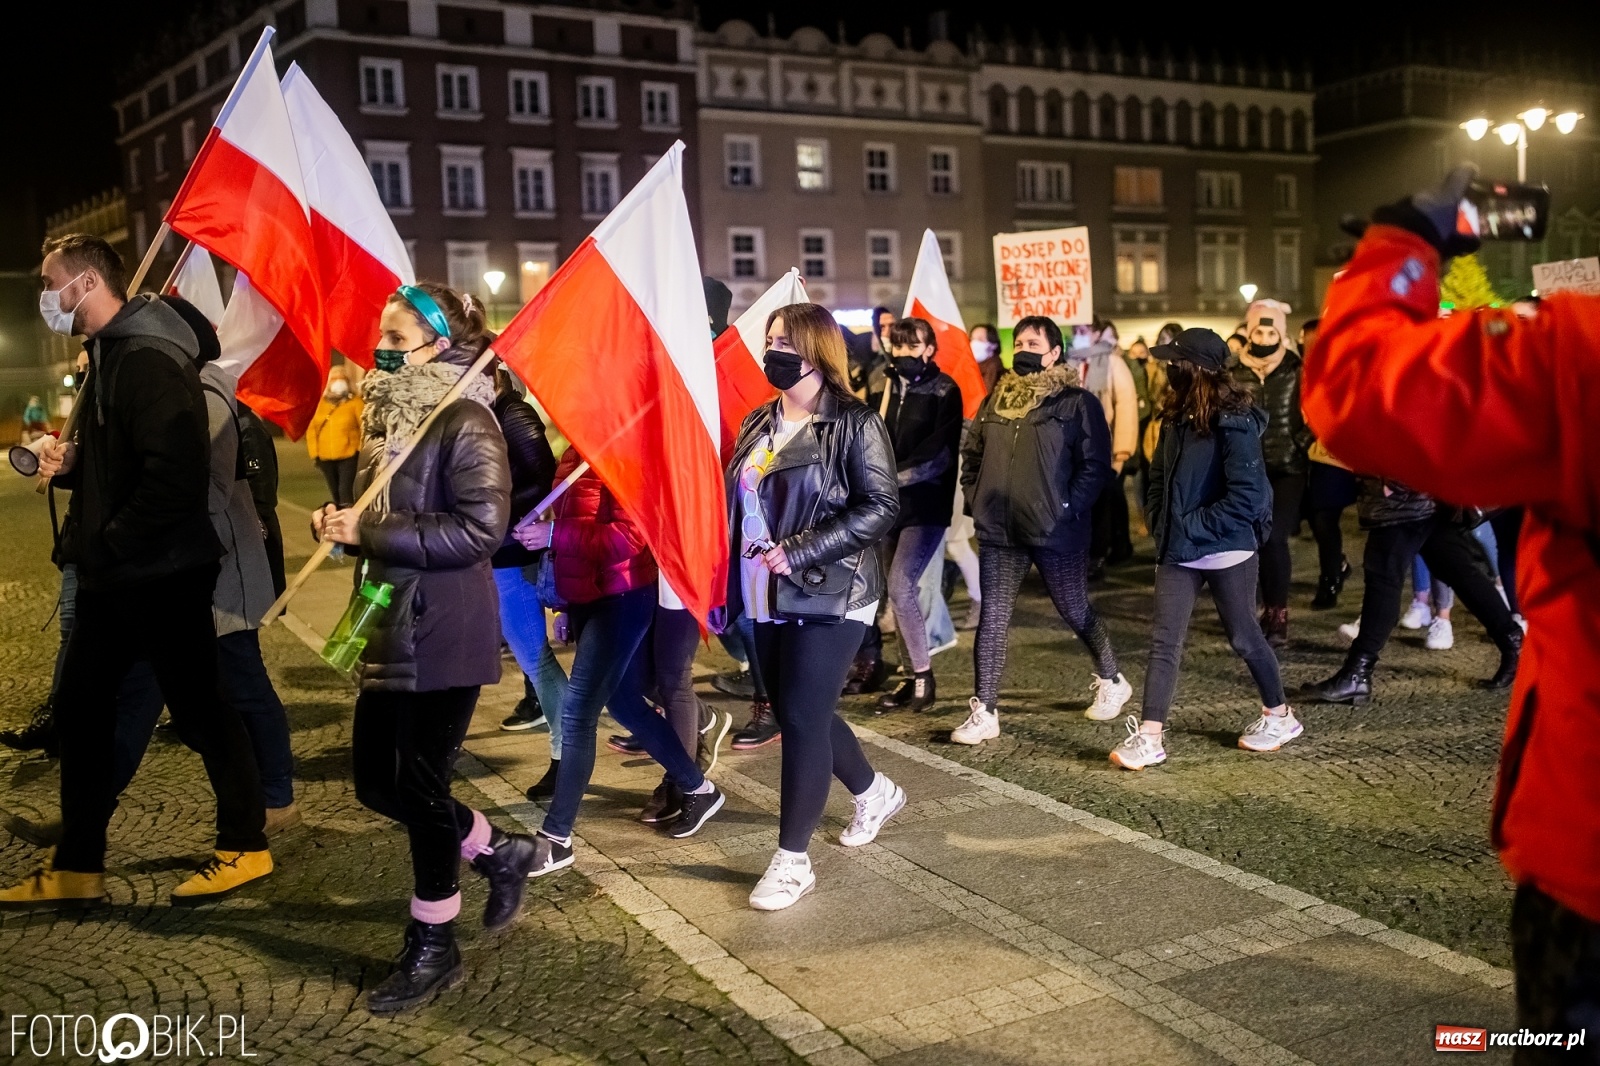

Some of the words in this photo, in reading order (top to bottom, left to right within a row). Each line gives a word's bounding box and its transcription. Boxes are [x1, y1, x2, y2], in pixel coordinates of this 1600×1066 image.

[1001, 241, 1055, 259] DOSTĘP
[1062, 239, 1084, 255] DO
[1001, 259, 1088, 283] BEZPIECZNEJ
[1010, 281, 1081, 301] LEGALNEJ
